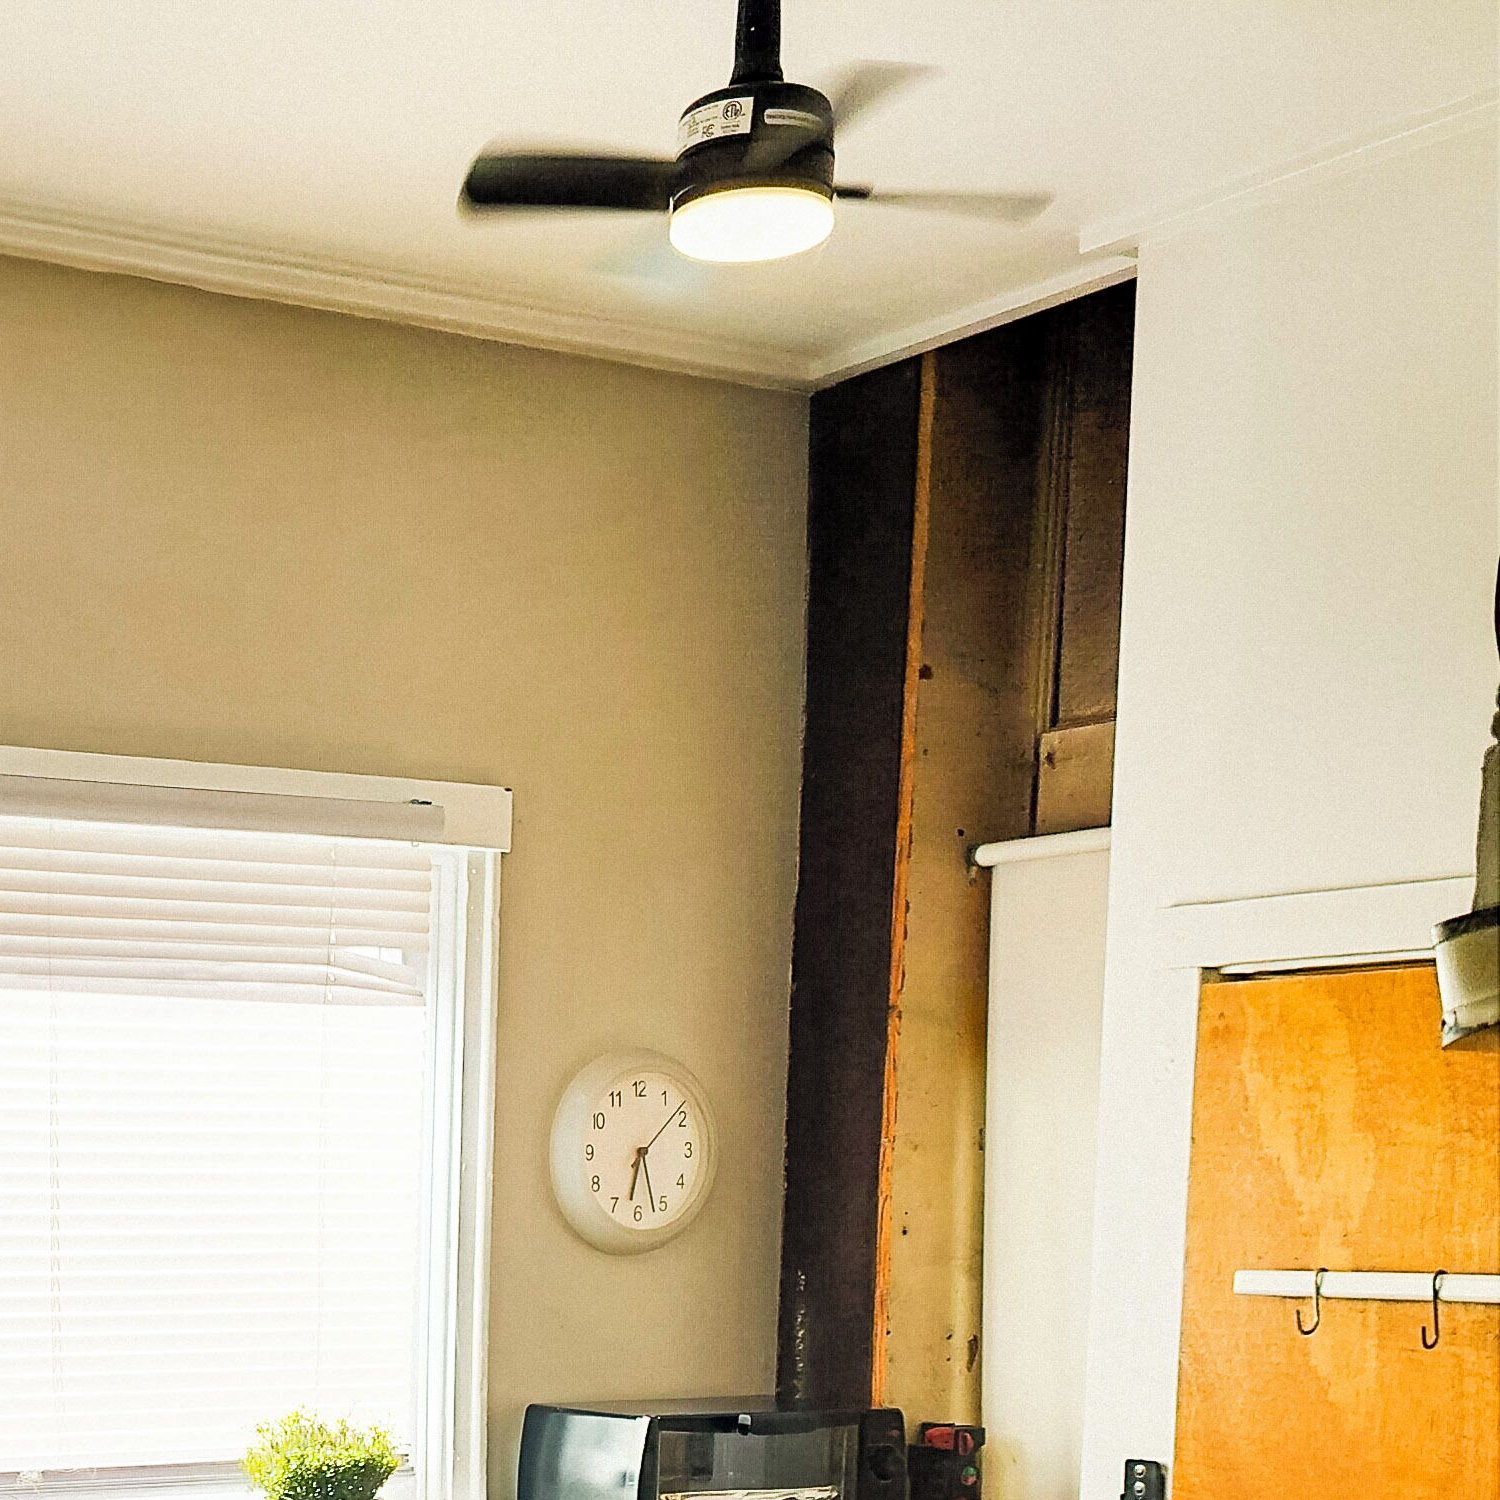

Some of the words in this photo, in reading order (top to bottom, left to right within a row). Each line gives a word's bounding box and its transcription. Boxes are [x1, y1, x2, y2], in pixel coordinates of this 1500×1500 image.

[631, 1080, 647, 1097] 12
[608, 1091, 622, 1107] 11
[661, 1090, 667, 1106] 1
[592, 1112, 605, 1129] 10
[678, 1111, 687, 1127] 2
[585, 1144, 594, 1161] 9
[684, 1142, 692, 1158] 3
[591, 1175, 600, 1192] 8
[676, 1173, 684, 1189] 4
[610, 1197, 619, 1213] 7
[659, 1196, 667, 1211] 5
[633, 1205, 642, 1221] 6
